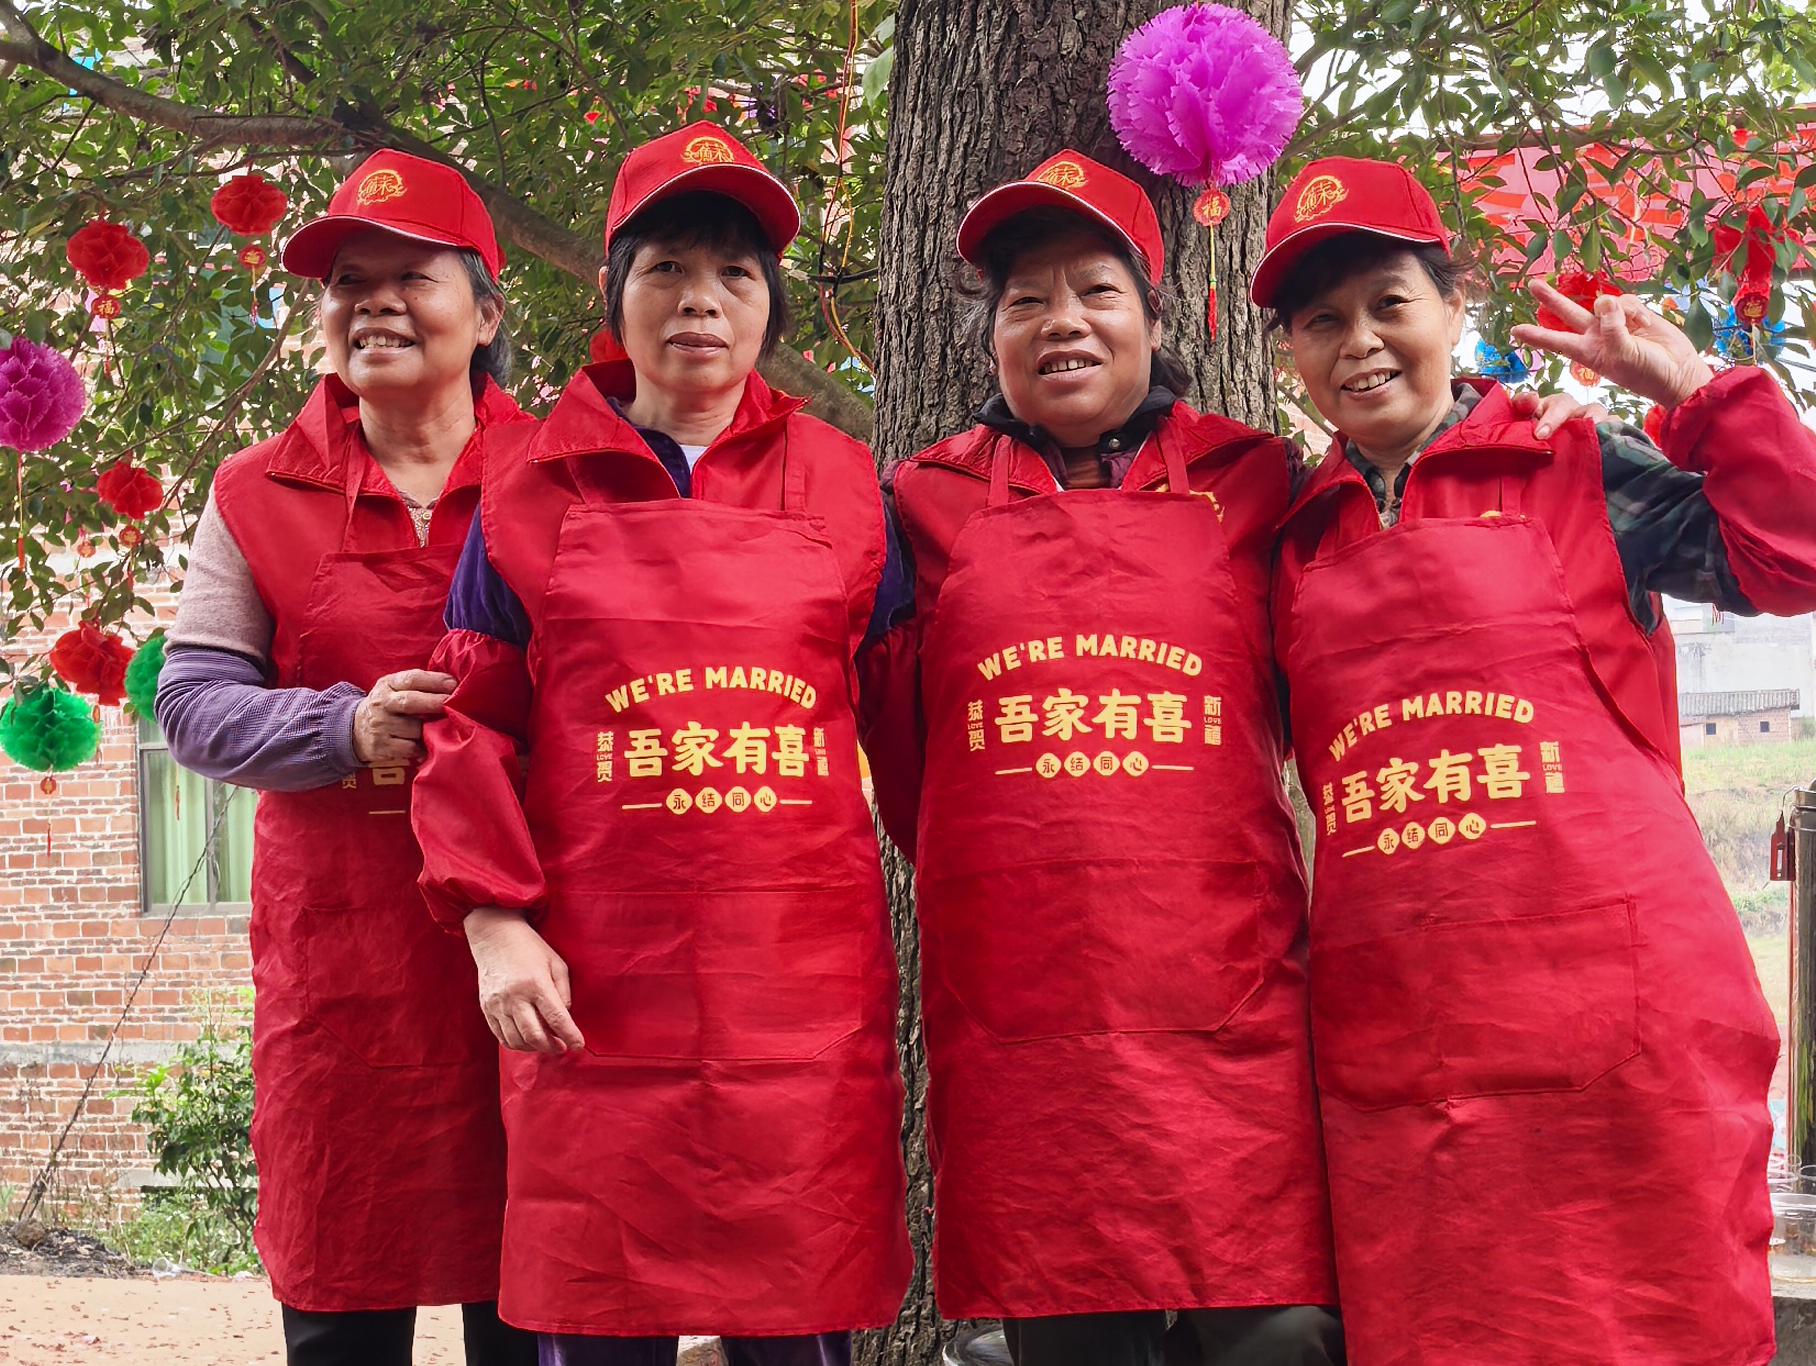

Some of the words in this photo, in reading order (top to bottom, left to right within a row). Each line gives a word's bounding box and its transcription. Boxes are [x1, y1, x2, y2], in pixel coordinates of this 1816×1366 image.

[977, 636, 1064, 681] WE'RE
[1075, 634, 1203, 677] MARRIED
[605, 668, 694, 714] WE'RE
[705, 666, 817, 710] MARRIED
[994, 688, 1192, 743] 吾家有喜
[1329, 703, 1392, 762] WE'RE
[1402, 691, 1534, 724] MARRIED
[624, 720, 810, 778] 吾家有喜
[1039, 754, 1145, 776] 永结同心
[670, 789, 774, 812] 永结同心
[1341, 743, 1531, 824] 吾家有喜
[1380, 816, 1483, 852] 永结同心
